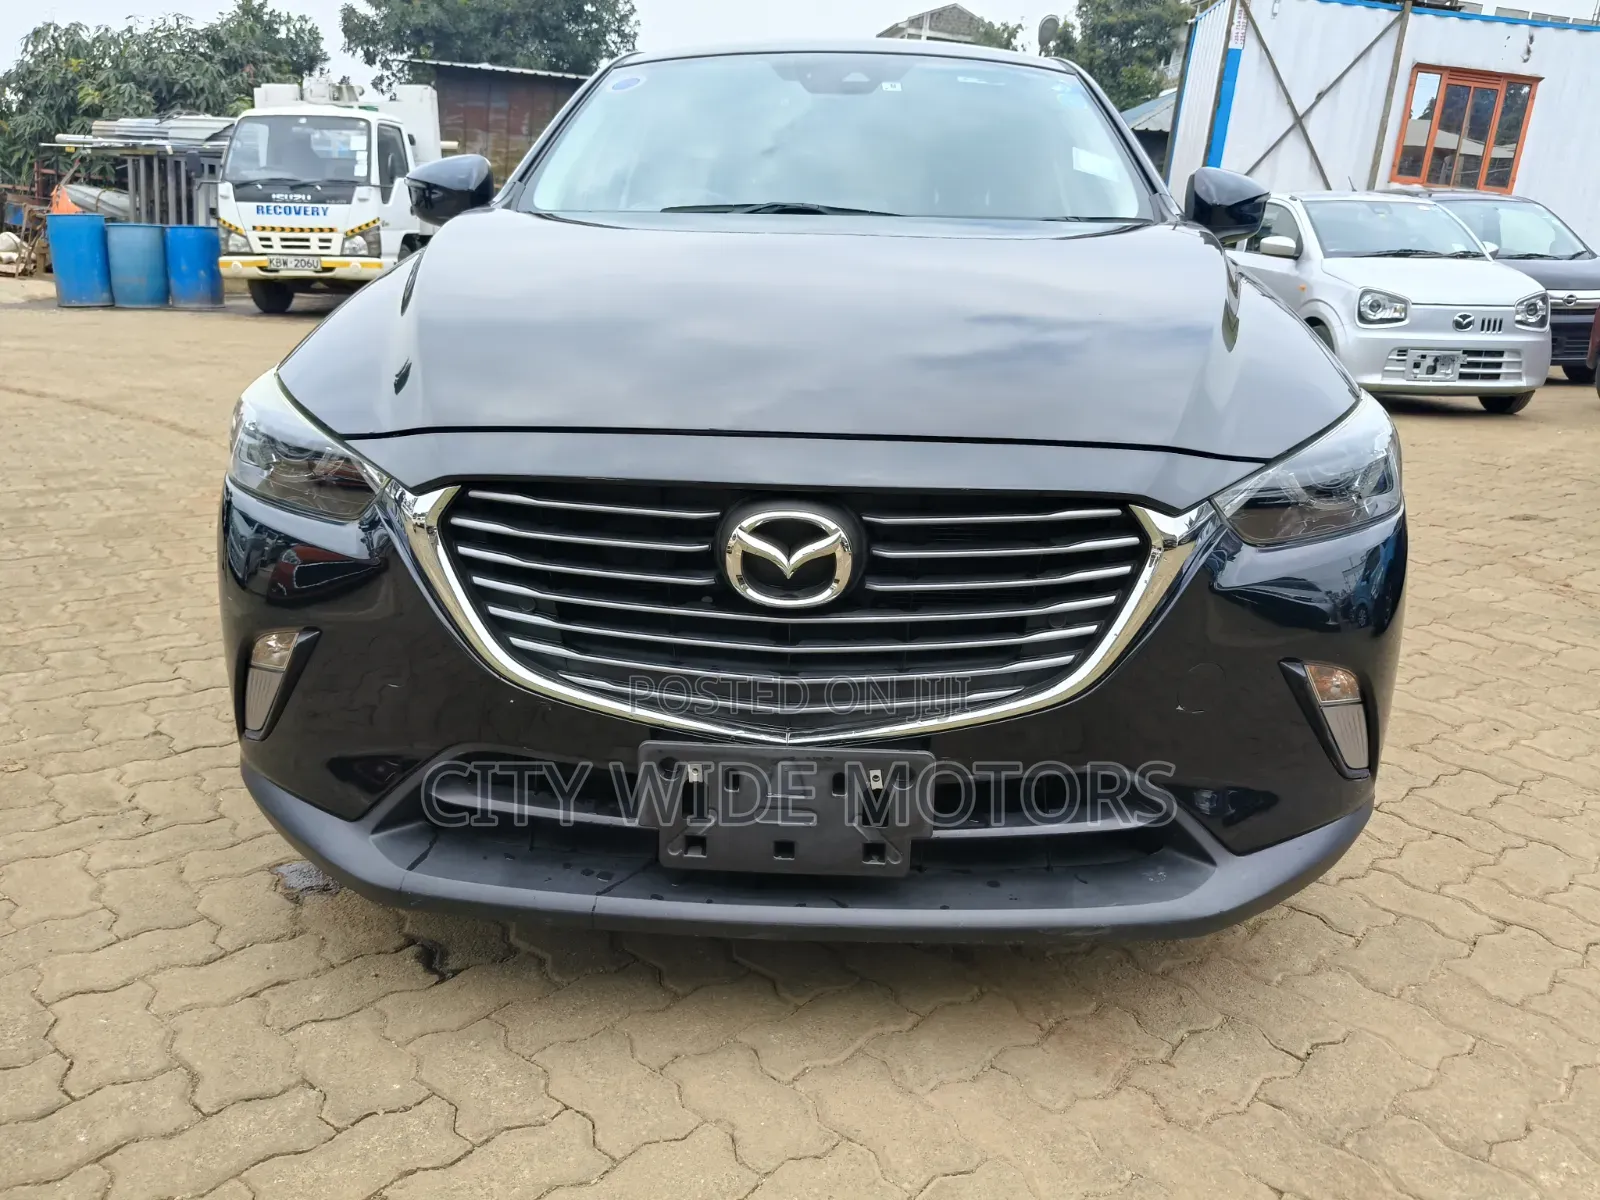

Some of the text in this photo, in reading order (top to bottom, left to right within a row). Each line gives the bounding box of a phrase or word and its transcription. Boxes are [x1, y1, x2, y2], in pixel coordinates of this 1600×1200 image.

[271, 193, 312, 202] ISUZU
[256, 205, 329, 216] RECOVERY
[269, 257, 319, 269] KBW 206U
